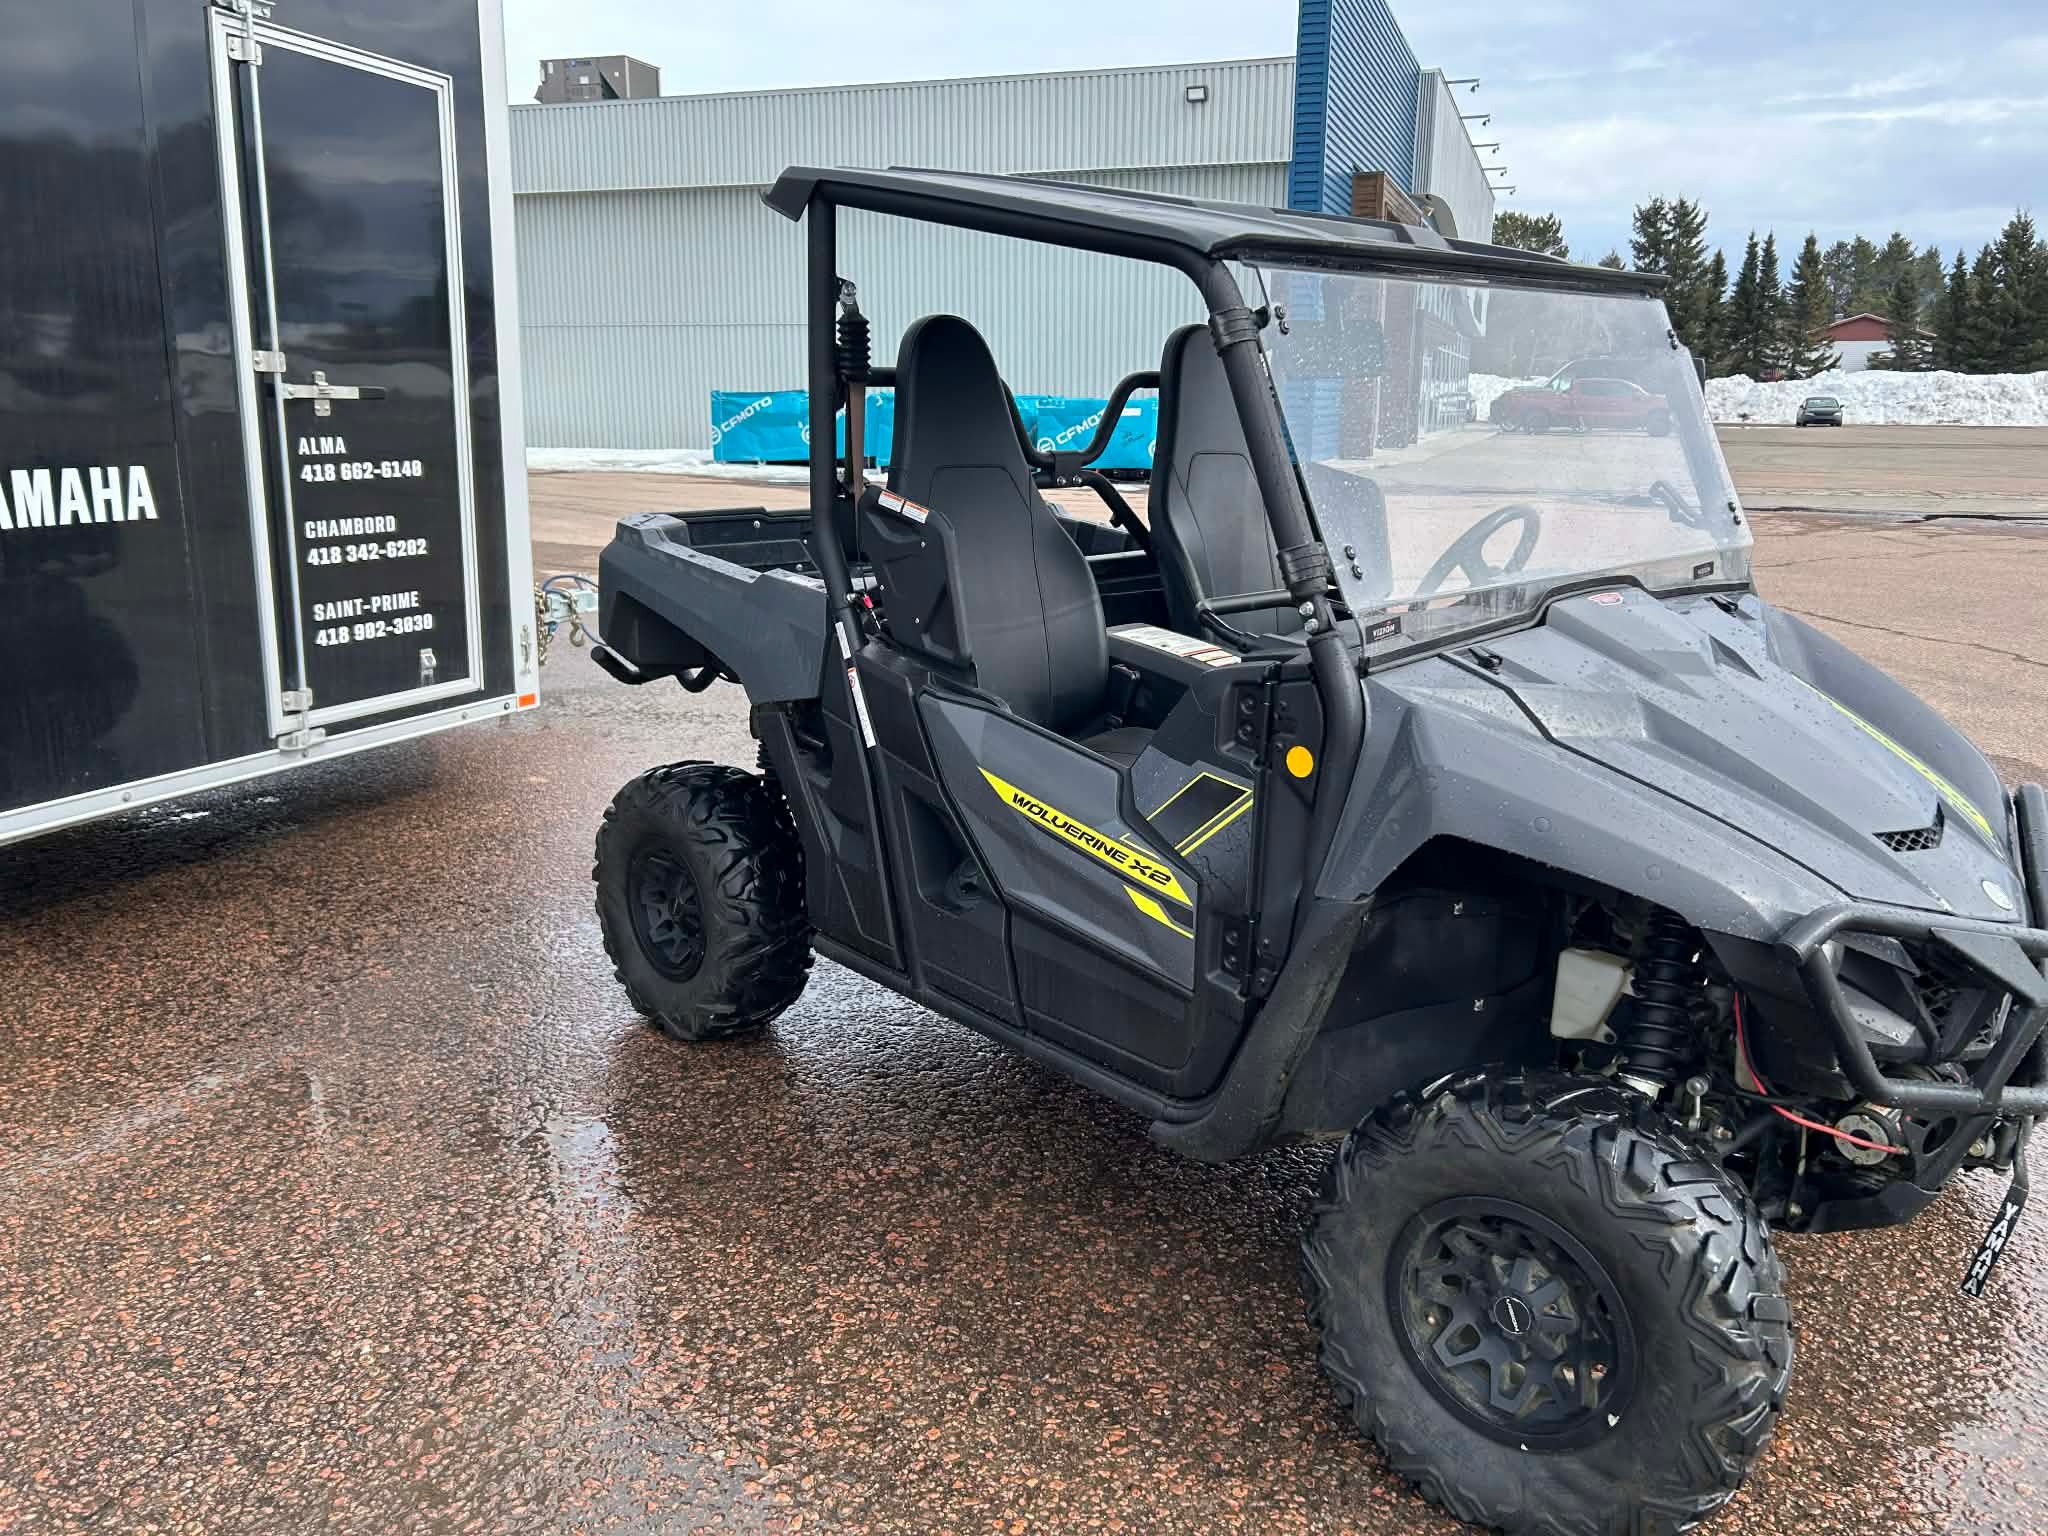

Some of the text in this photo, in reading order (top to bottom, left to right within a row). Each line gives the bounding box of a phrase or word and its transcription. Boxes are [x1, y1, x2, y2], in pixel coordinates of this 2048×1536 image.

[720, 396, 773, 433] CFMOTO
[298, 436, 347, 455] ALMA
[301, 459, 423, 482] 418 662-6140
[304, 515, 397, 539] CHAMBORD
[307, 538, 427, 566] 418 342-6202
[313, 590, 420, 621] SAINT-PRIME
[315, 625, 350, 647] 418
[1012, 793, 1172, 886] WOLVERINE X2
[1962, 1201, 2020, 1295] YAMAHA
